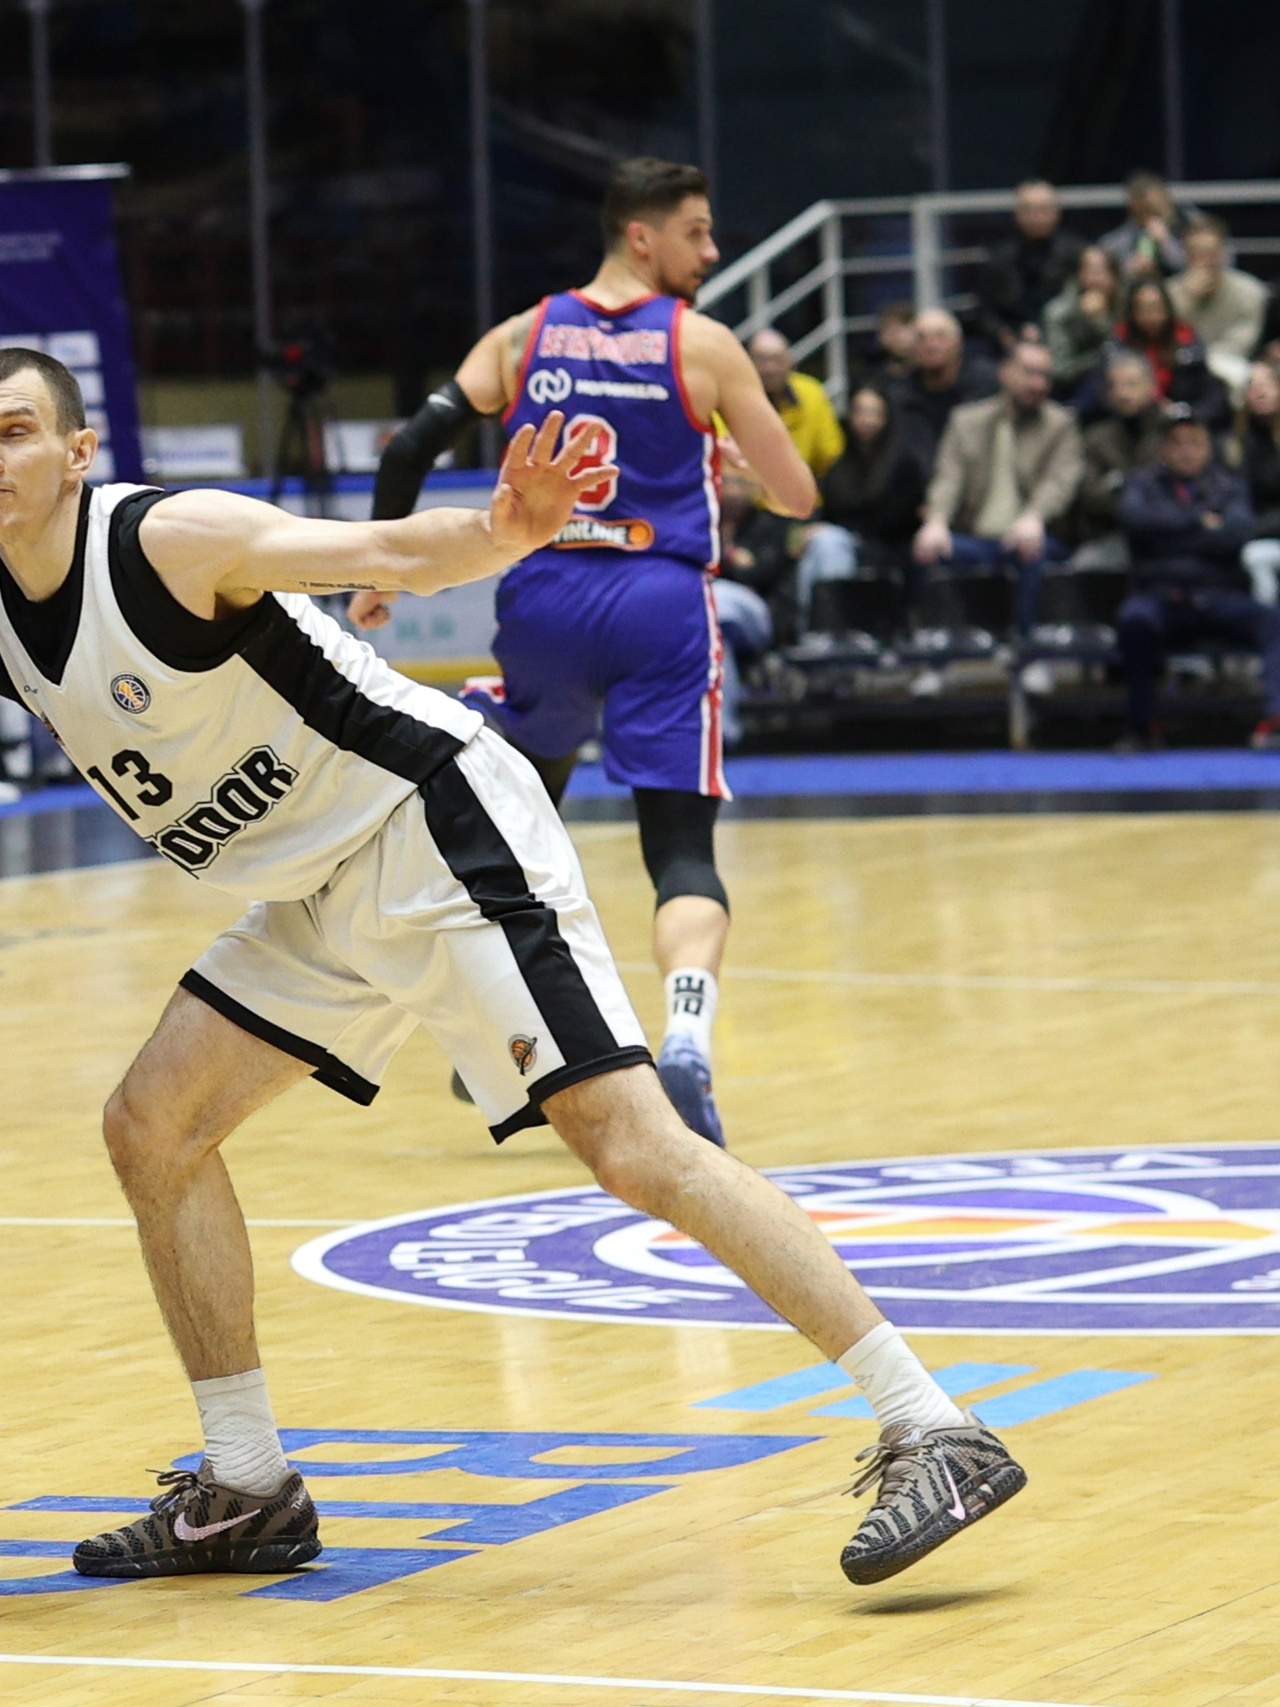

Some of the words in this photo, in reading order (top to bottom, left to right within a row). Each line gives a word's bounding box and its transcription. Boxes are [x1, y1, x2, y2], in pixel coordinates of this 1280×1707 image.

[86, 749, 173, 821] 13
[144, 745, 299, 880] ODOR
[389, 1240, 734, 1310] LEAGUE
